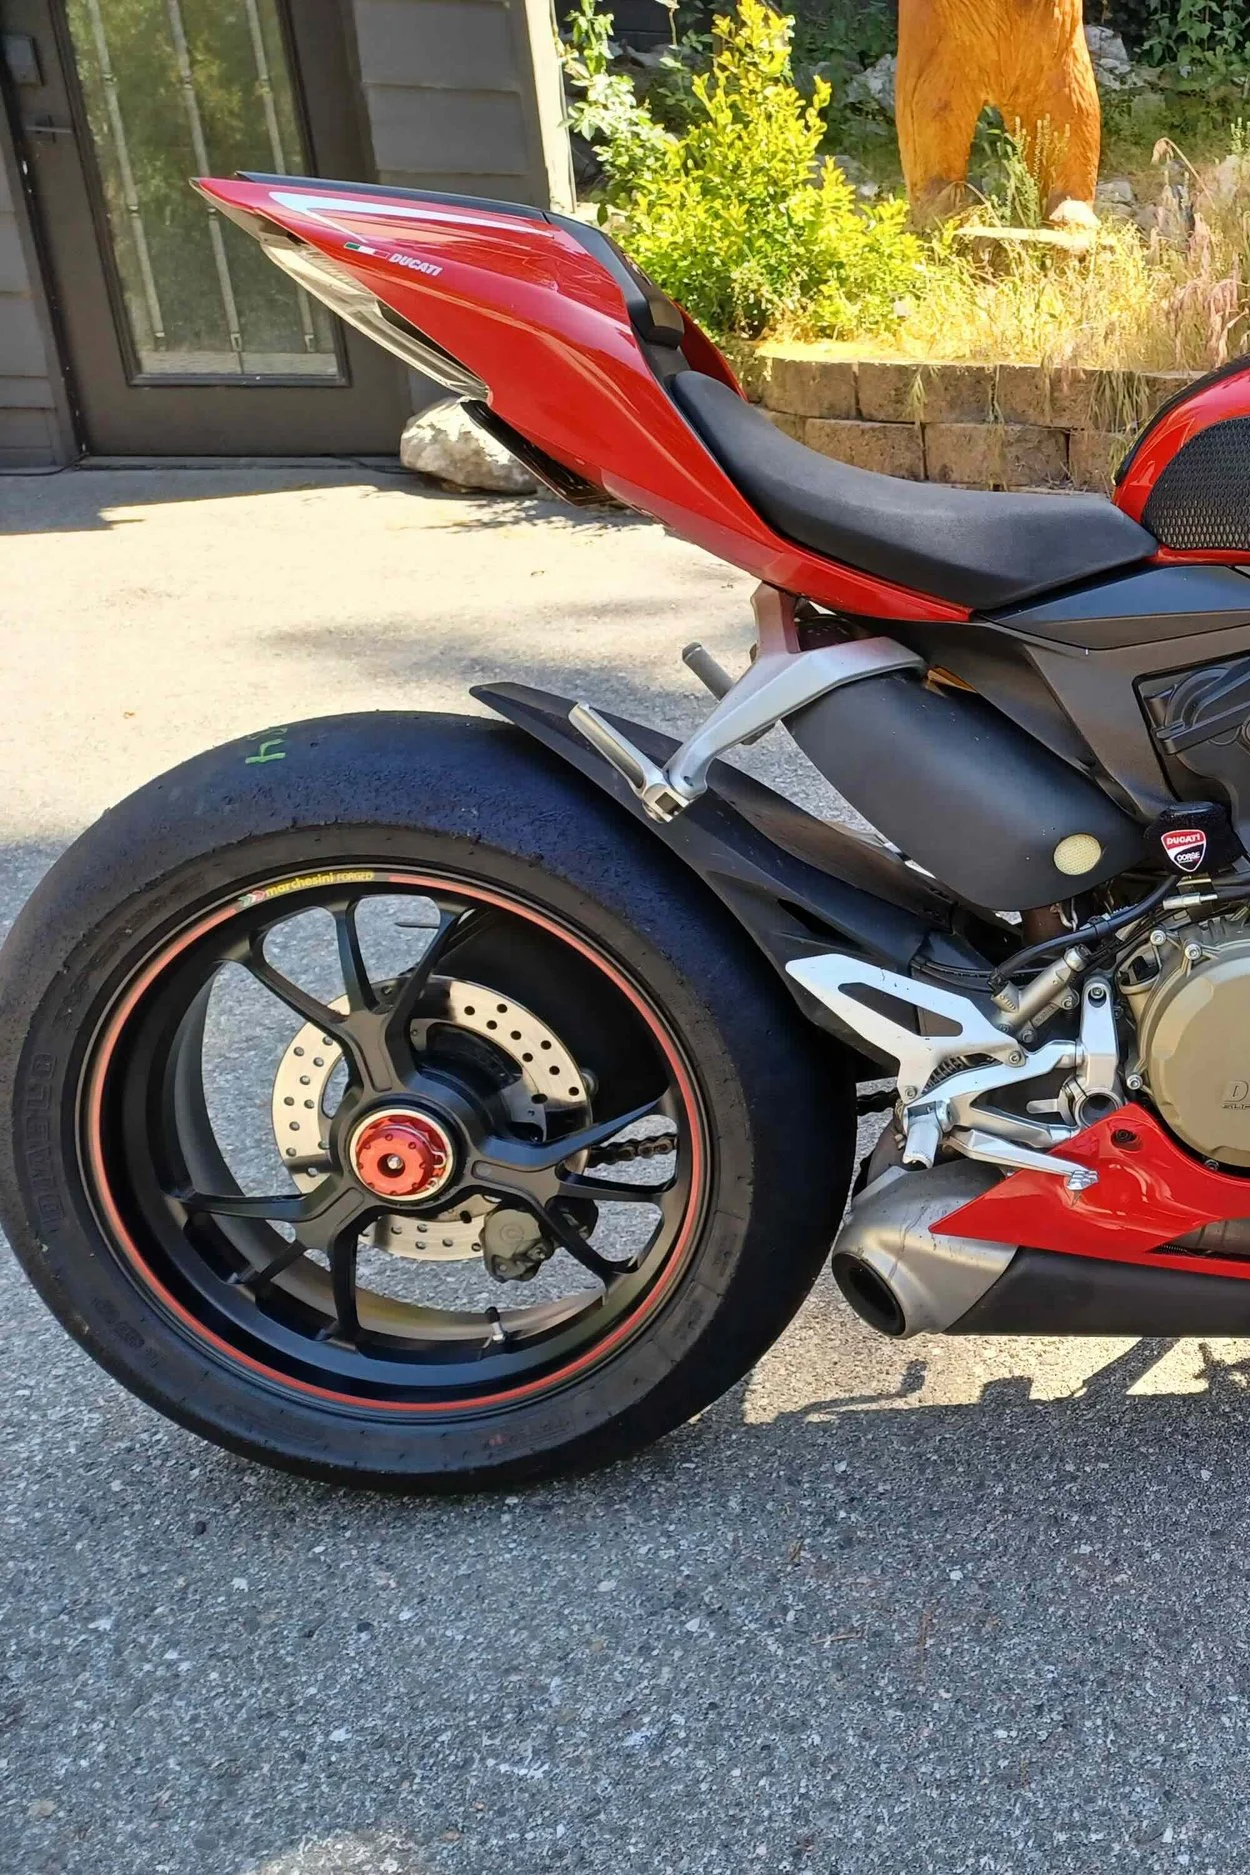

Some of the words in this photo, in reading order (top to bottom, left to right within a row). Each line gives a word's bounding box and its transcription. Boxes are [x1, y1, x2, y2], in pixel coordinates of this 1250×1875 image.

[388, 253, 443, 276] DUCATI
[1166, 834, 1201, 845] DUCATI
[265, 873, 334, 897] marchesini
[336, 871, 375, 881] FORGED
